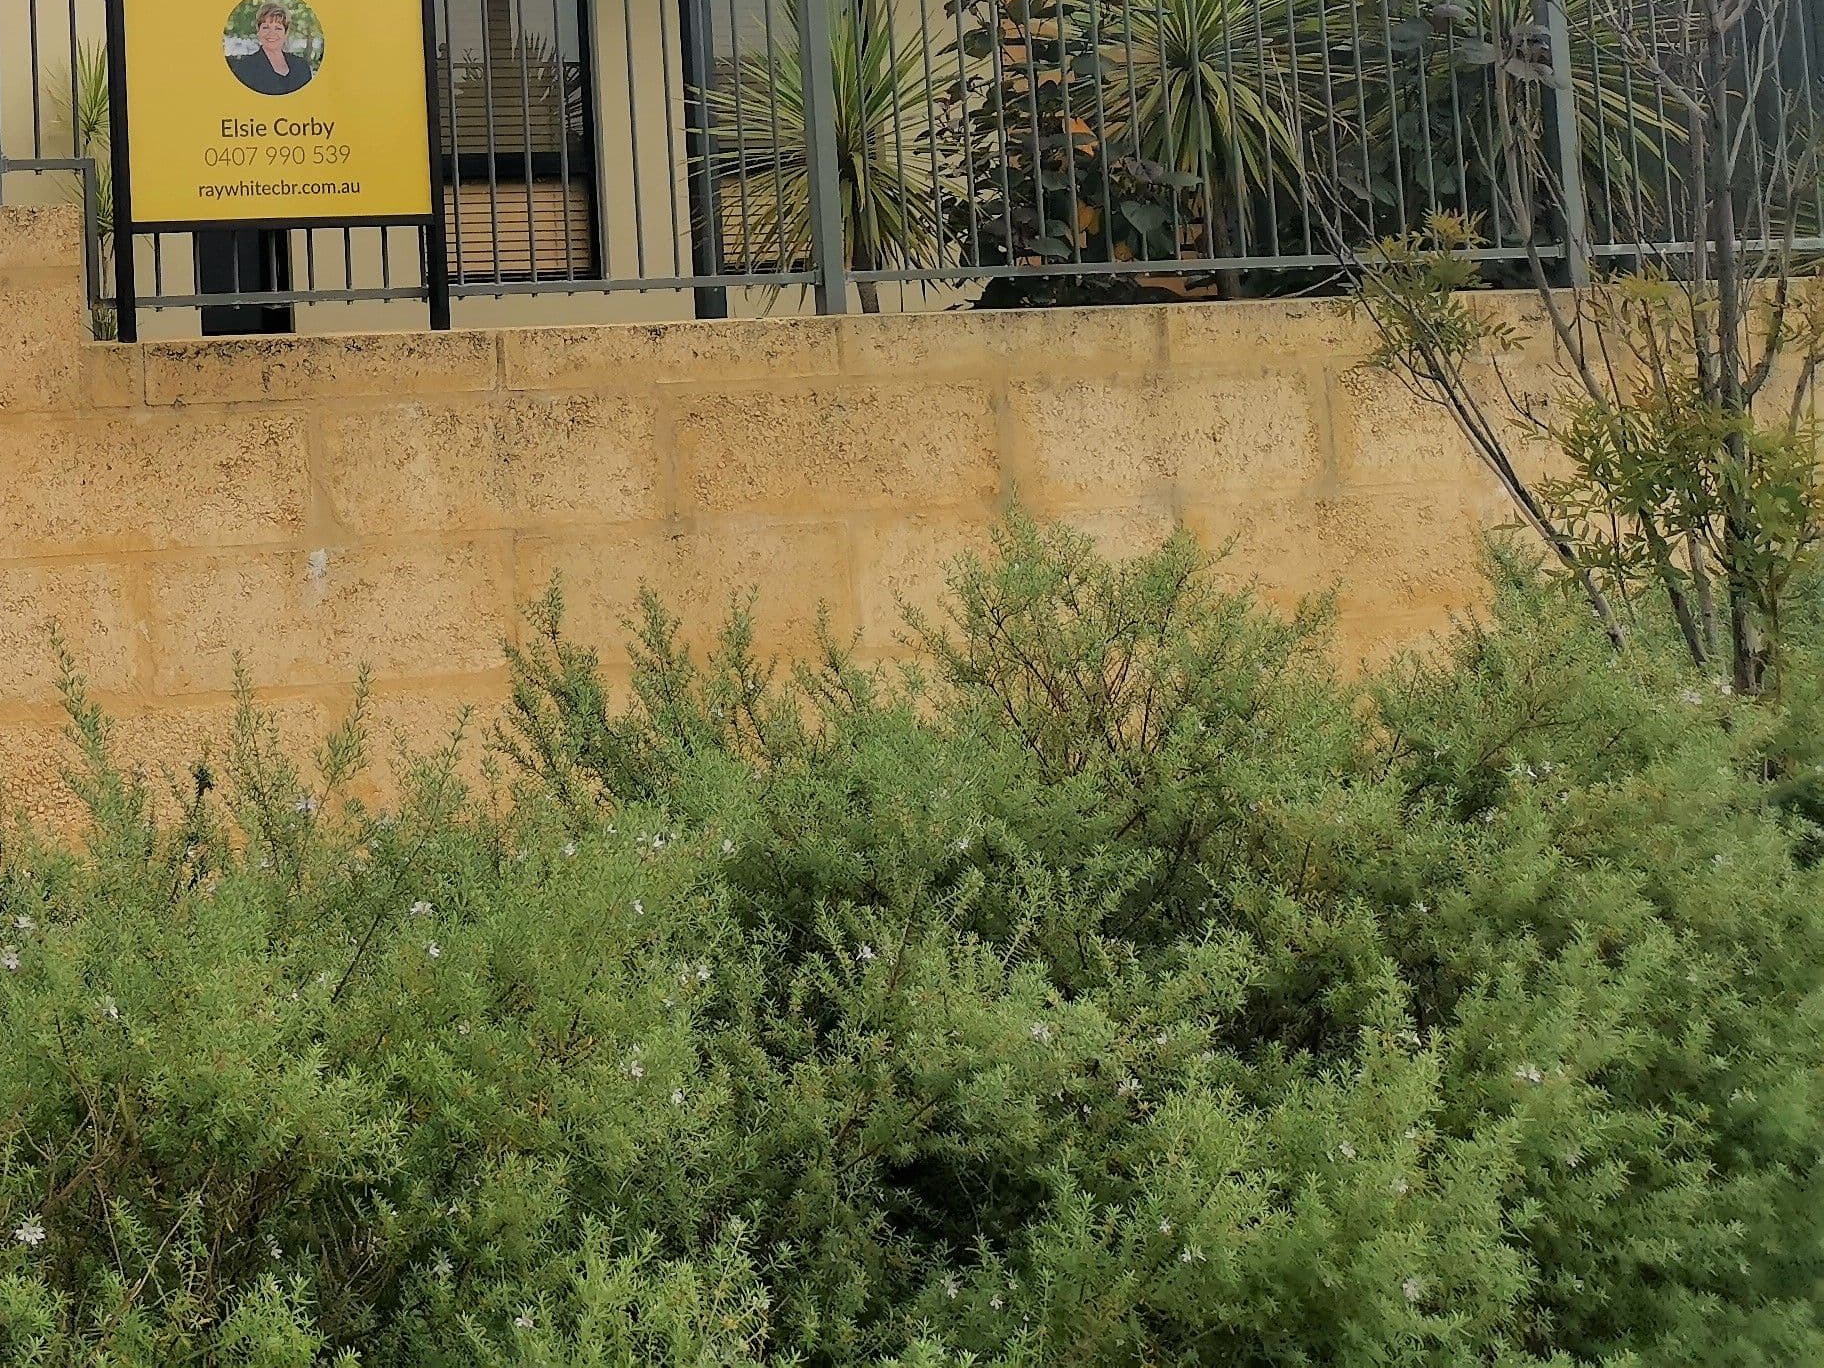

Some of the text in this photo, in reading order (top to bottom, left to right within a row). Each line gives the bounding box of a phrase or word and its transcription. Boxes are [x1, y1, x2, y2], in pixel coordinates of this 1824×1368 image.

[221, 117, 335, 140] Elsie Corby
[204, 145, 351, 167] 0407 990 539
[199, 179, 361, 201] raywhitecbr.com.au
